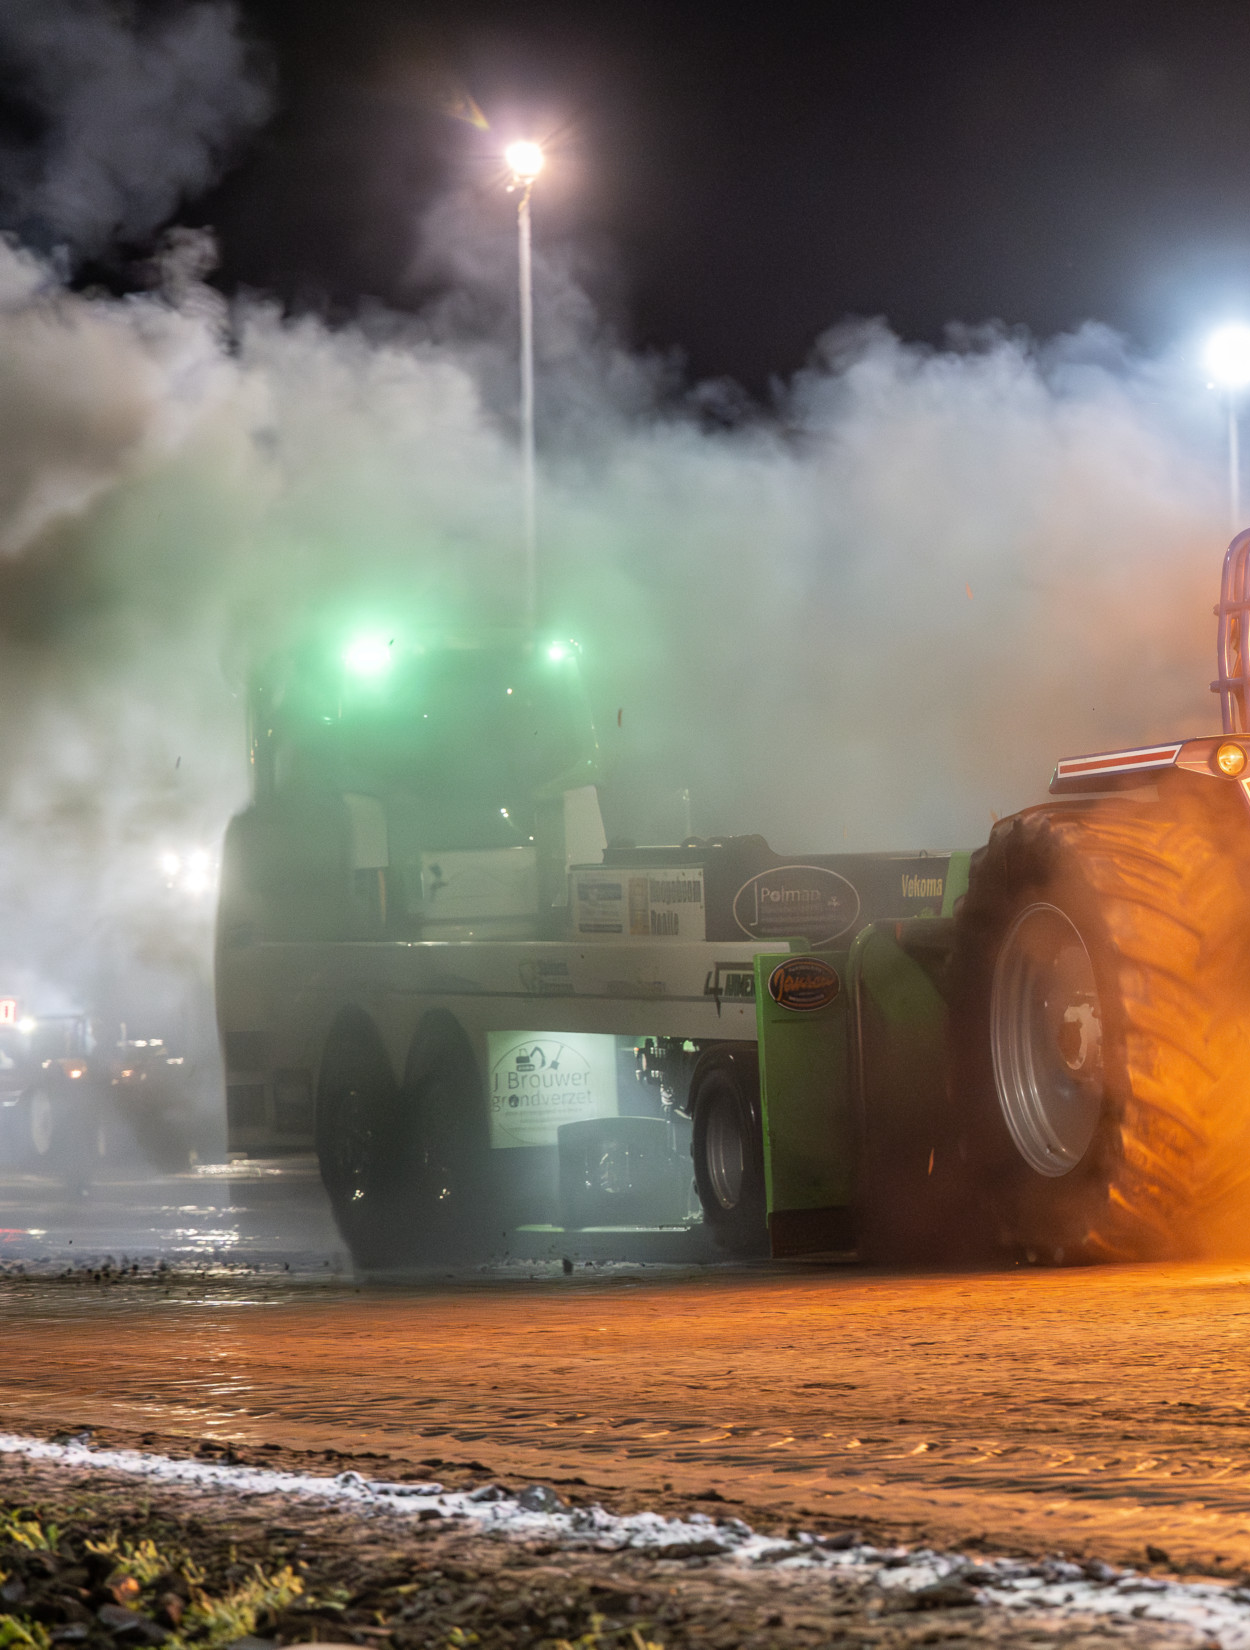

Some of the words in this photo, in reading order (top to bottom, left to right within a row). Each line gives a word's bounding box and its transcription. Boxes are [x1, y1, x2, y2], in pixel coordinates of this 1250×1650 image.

[902, 873, 943, 898] Vekoma
[493, 1072, 499, 1092] J
[508, 1071, 591, 1090] Brouwer
[491, 1089, 593, 1113] grondverzet
